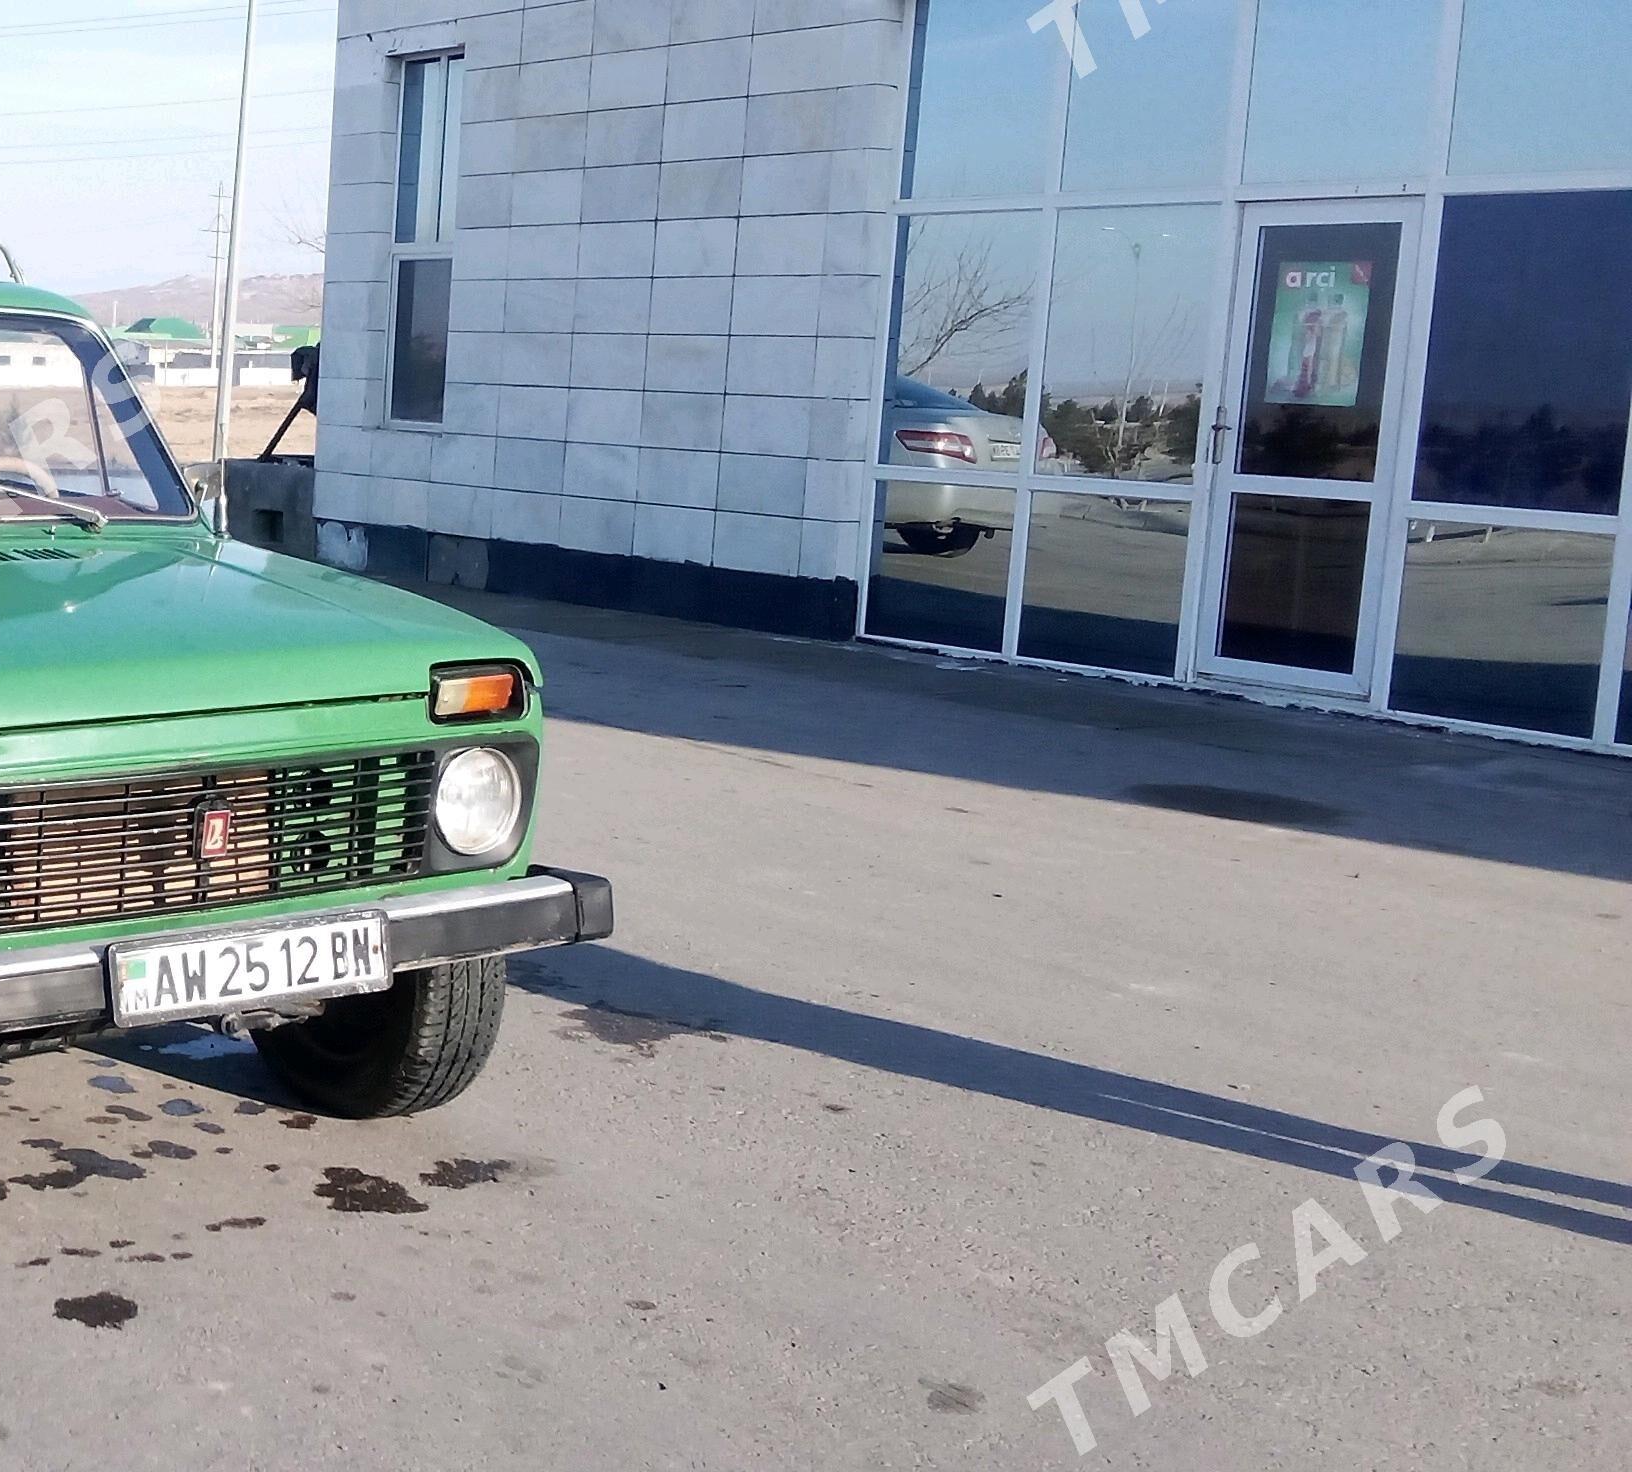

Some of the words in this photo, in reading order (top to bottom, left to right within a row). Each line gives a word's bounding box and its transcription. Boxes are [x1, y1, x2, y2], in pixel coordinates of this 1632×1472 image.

[154, 950, 207, 1007] AW
[218, 941, 269, 998] 25
[279, 935, 319, 988] 12
[331, 926, 372, 980] BN
